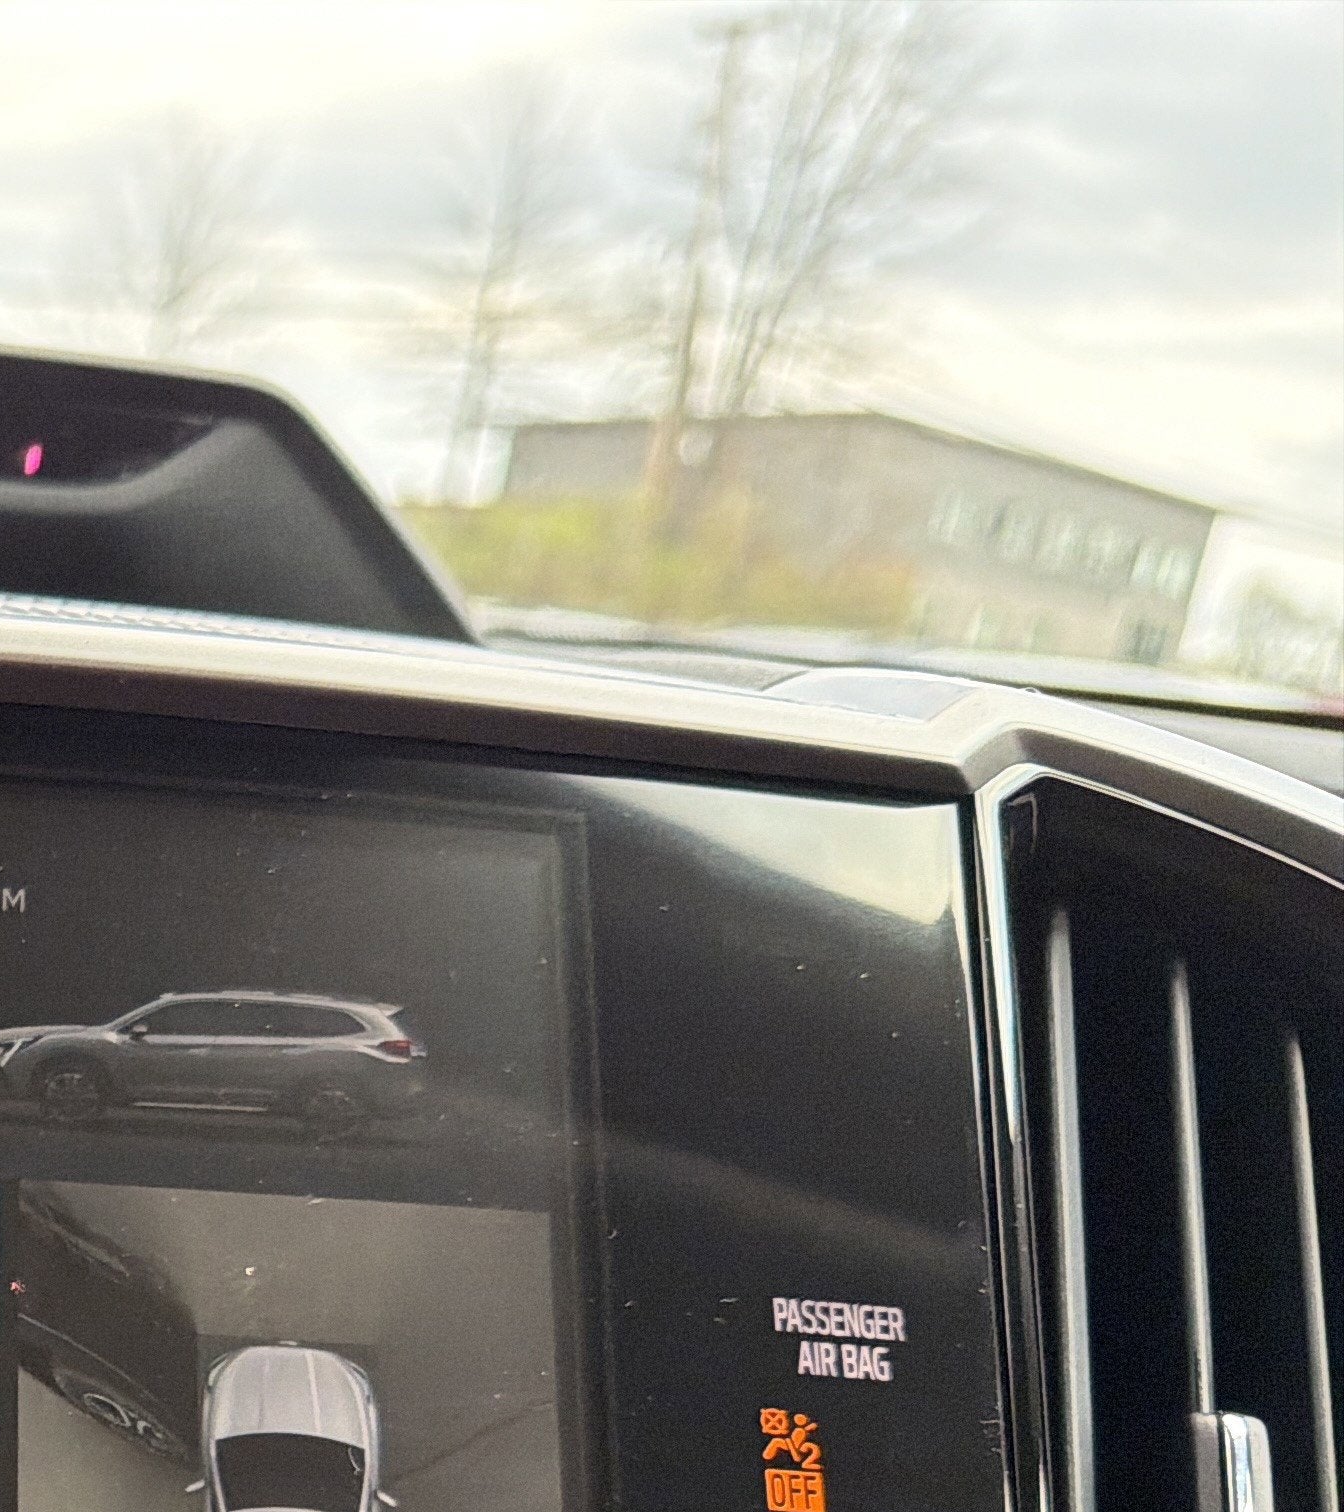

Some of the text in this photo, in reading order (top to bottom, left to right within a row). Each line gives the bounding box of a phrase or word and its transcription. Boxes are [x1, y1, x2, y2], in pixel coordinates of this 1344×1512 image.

[772, 1297, 906, 1342] PASSENGER
[797, 1340, 894, 1382] AIR BAG
[769, 1473, 818, 1510] OFF
